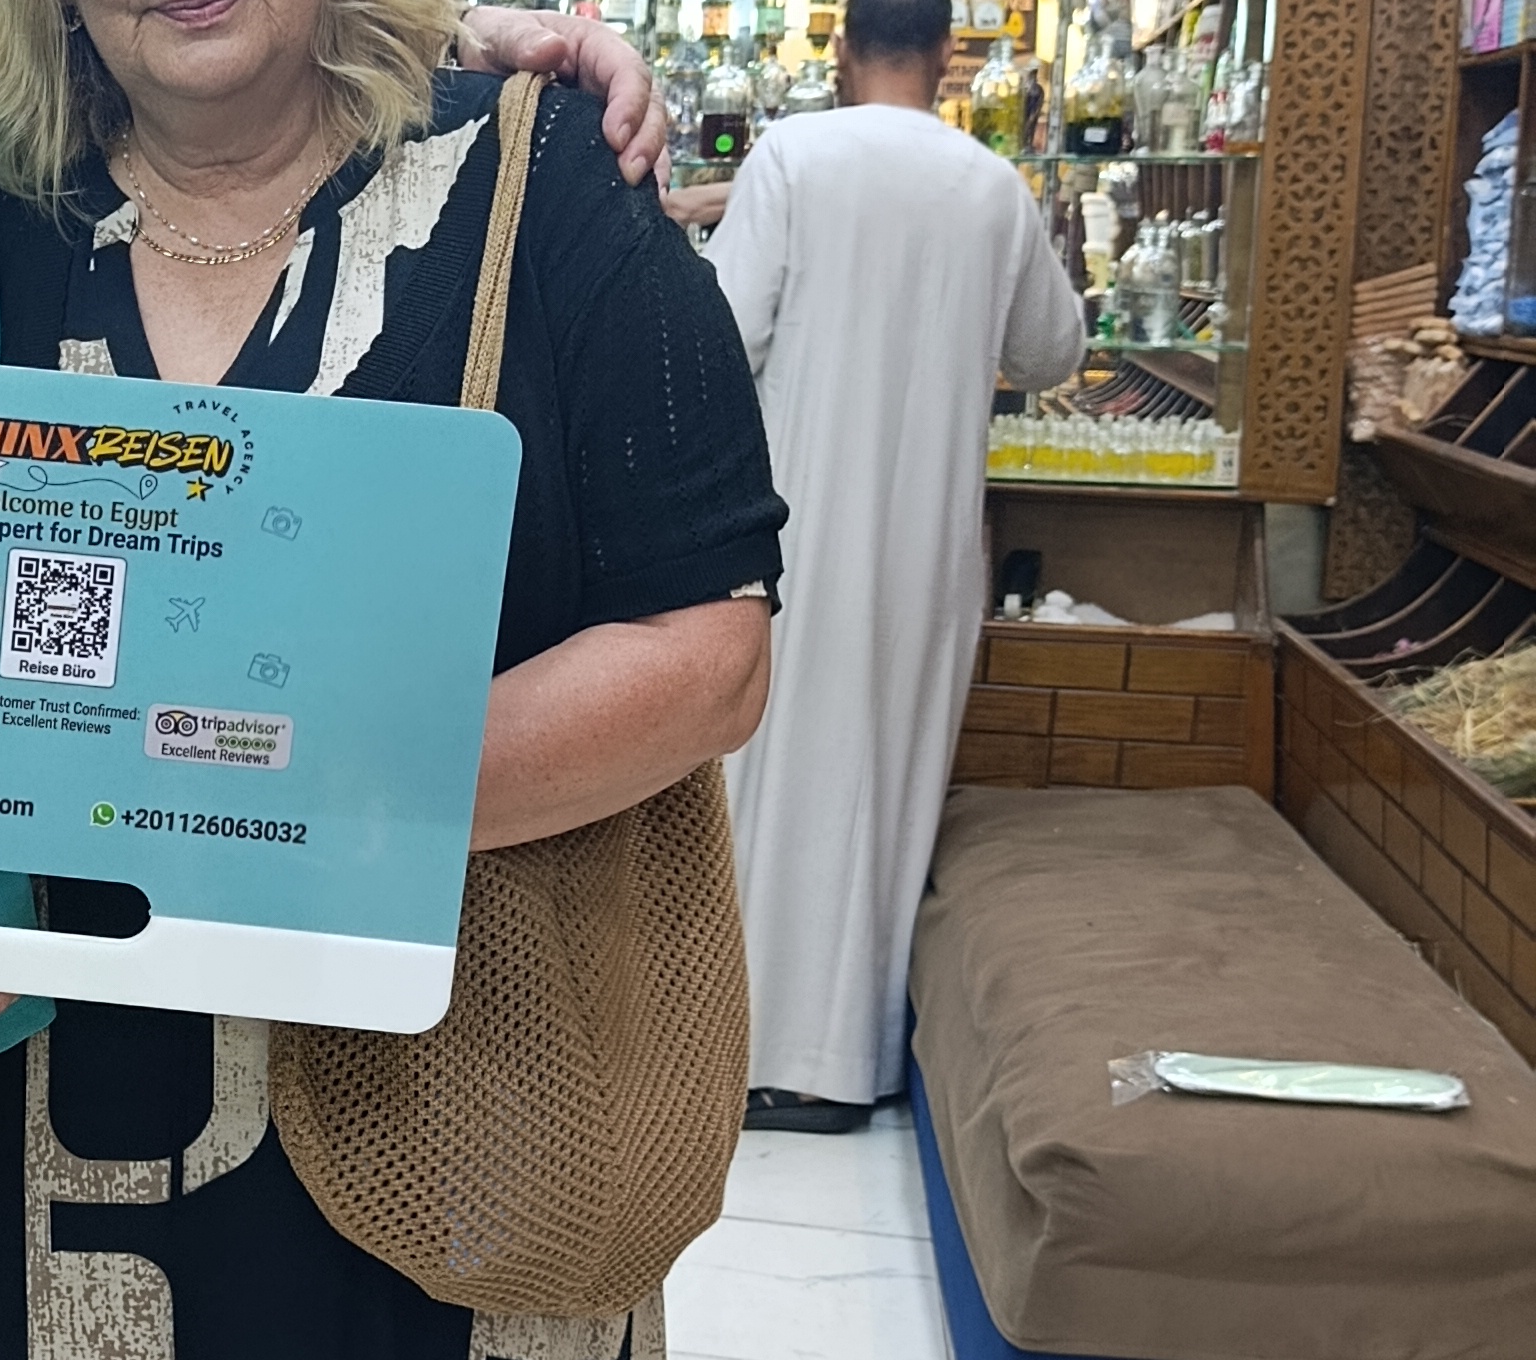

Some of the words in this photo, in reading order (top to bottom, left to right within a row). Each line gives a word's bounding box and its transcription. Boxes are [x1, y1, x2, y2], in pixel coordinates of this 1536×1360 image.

[87, 425, 234, 478] REISEN
[172, 399, 239, 423] TRAVEL
[224, 429, 254, 495] AGENCY
[80, 499, 104, 521] to
[110, 501, 179, 531] Egypt
[50, 522, 82, 545] for
[87, 526, 161, 552] Dream
[167, 533, 224, 561] Trips
[18, 660, 59, 676] Reise
[63, 662, 97, 680] Büro
[39, 698, 70, 714] Trust
[73, 701, 141, 721] Confirmed:
[2, 712, 58, 730] Excellent
[61, 718, 112, 735] Reviews
[201, 715, 280, 736] tripadvisor
[161, 743, 216, 760] Excellent
[219, 748, 270, 766] Reviews
[121, 809, 307, 845] +201126063032
